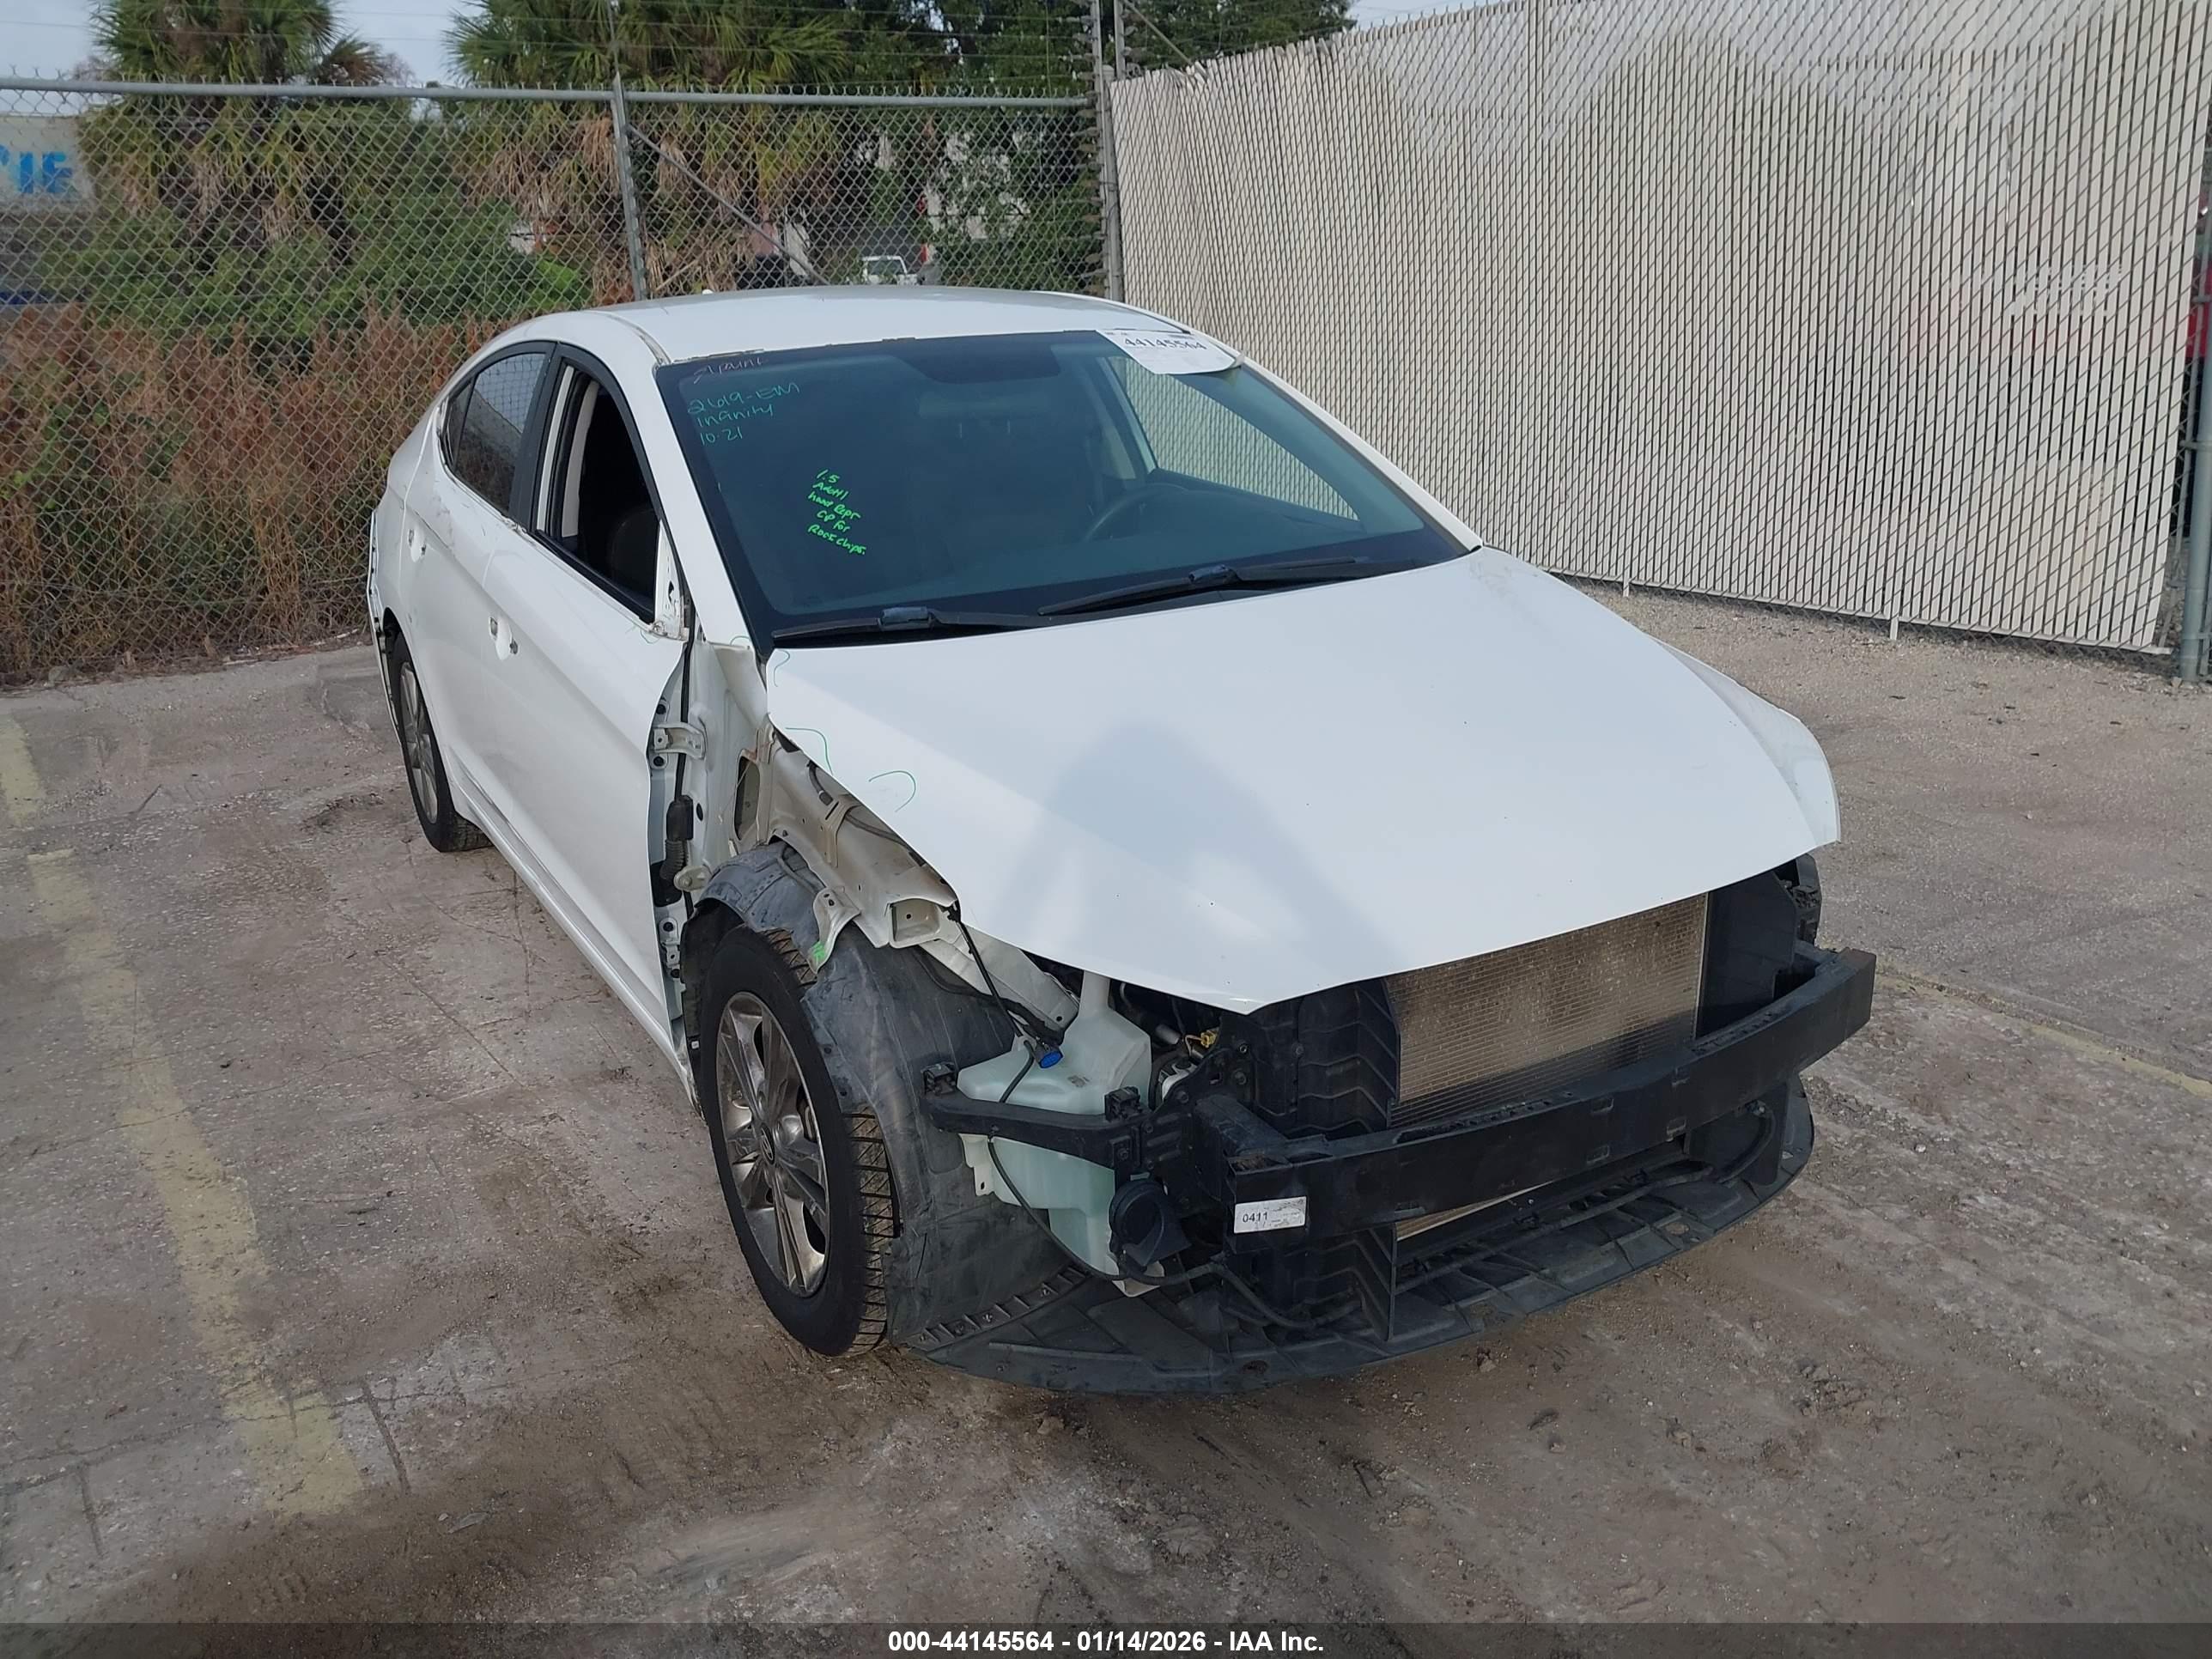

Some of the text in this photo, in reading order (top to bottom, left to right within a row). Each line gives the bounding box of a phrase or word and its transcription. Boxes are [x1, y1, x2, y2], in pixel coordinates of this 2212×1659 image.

[1125, 337, 1207, 350] 44145564
[817, 469, 840, 483] 1.5
[1243, 1212, 1268, 1223] 0411
